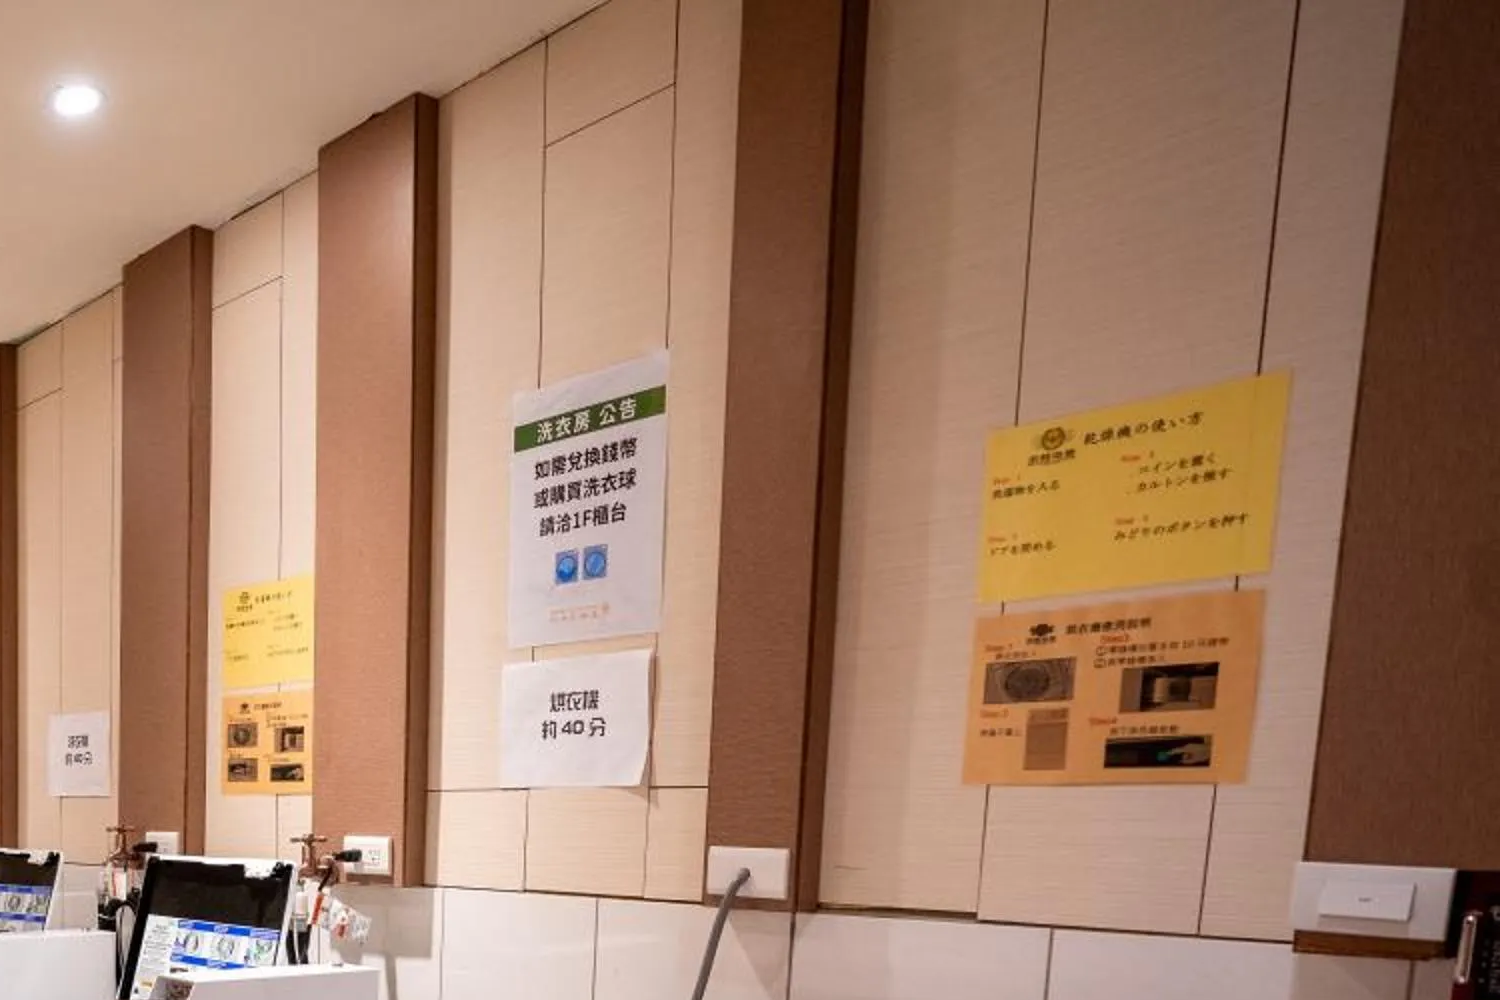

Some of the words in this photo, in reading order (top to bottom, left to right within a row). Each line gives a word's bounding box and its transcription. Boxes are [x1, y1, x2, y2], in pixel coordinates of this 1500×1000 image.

[537, 408, 591, 443] 洗衣房
[599, 398, 636, 426] 公告
[534, 437, 638, 480] 如需兌換錢幣
[533, 467, 637, 509] 或購買洗衣球
[539, 501, 627, 536] 請洽1F櫃台
